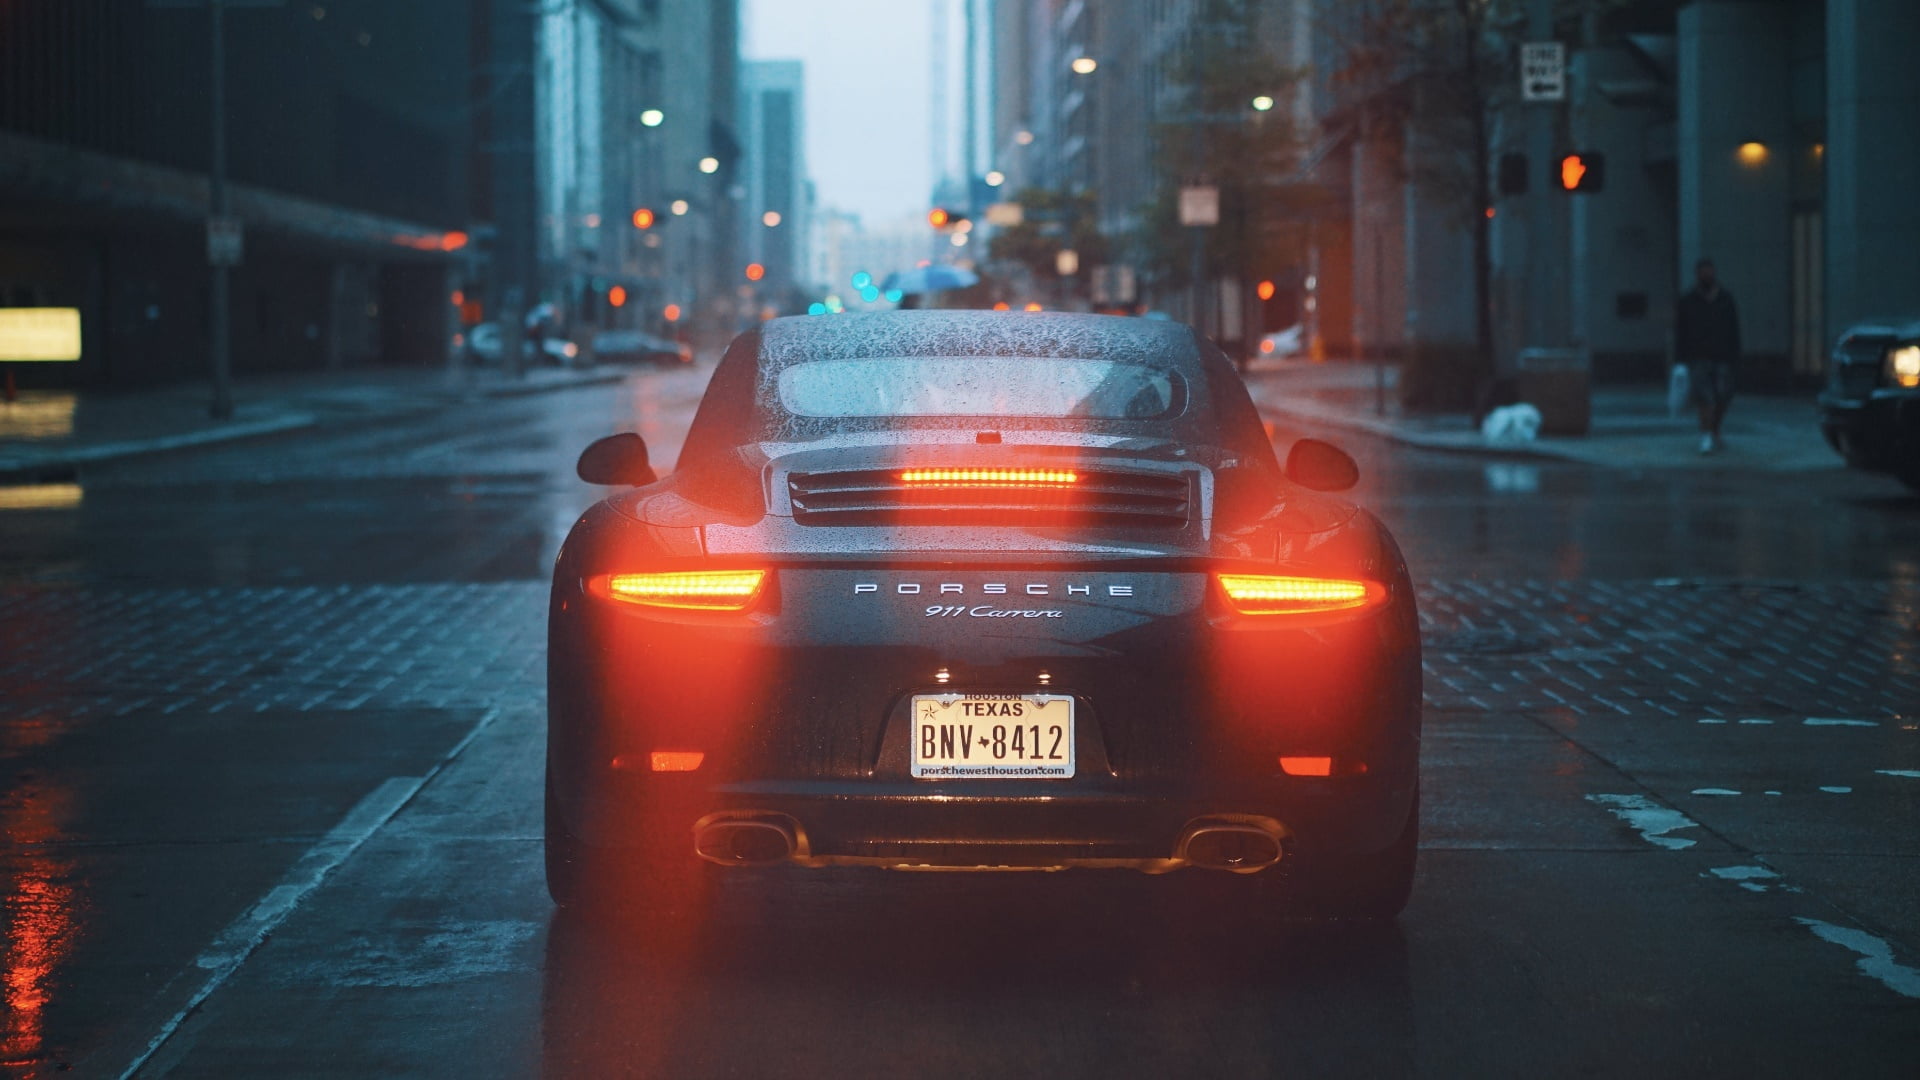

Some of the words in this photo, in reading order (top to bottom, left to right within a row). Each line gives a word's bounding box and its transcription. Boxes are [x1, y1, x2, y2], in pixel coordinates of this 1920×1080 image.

[854, 583, 1134, 596] PORSCHE
[925, 605, 966, 617] 911
[969, 605, 1063, 618] Carrera
[961, 702, 1023, 717] TEXAS
[921, 724, 973, 760] BNV
[992, 724, 1063, 760] 8412
[920, 766, 1065, 776] porschewesthouston.com
